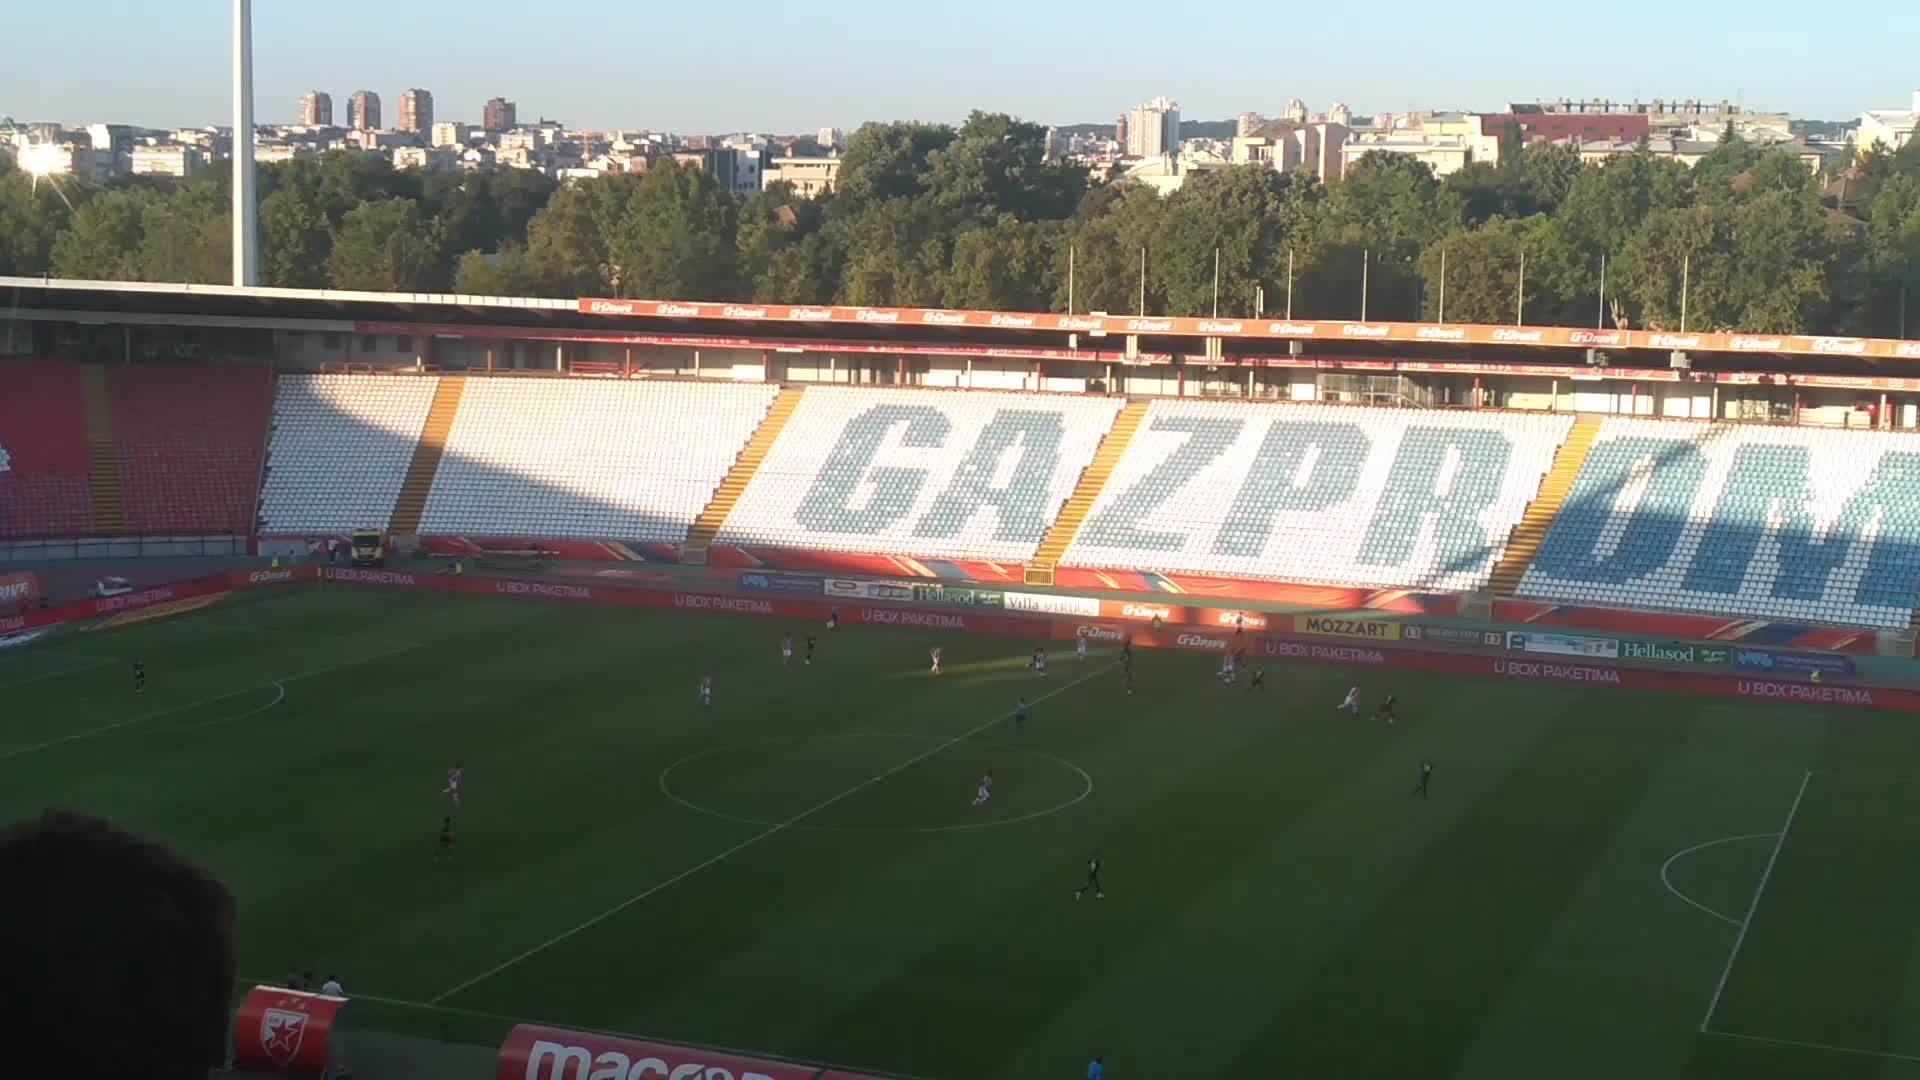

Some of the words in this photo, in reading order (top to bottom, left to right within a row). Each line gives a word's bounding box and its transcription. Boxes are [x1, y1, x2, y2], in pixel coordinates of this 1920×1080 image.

[496, 580, 506, 592] U
[508, 581, 529, 594] BOX
[675, 594, 685, 607] U
[686, 595, 711, 608] BOX
[713, 598, 773, 613] PAKETIMA
[863, 609, 873, 621] U
[874, 610, 899, 624] BOX
[902, 613, 964, 628] PAKETIMA
[1306, 618, 1388, 637] MOZZART
[1265, 640, 1277, 654] U
[1279, 642, 1308, 657] BOX
[1311, 646, 1384, 663] PAKETIMA
[1624, 642, 1695, 663] Hellasod
[1494, 660, 1505, 674] U
[1508, 662, 1540, 677] BOX
[1543, 664, 1620, 684] PAKETIMA
[1738, 680, 1750, 694] U
[1753, 682, 1786, 697] BOX
[1790, 685, 1873, 704] PAKETIMA
